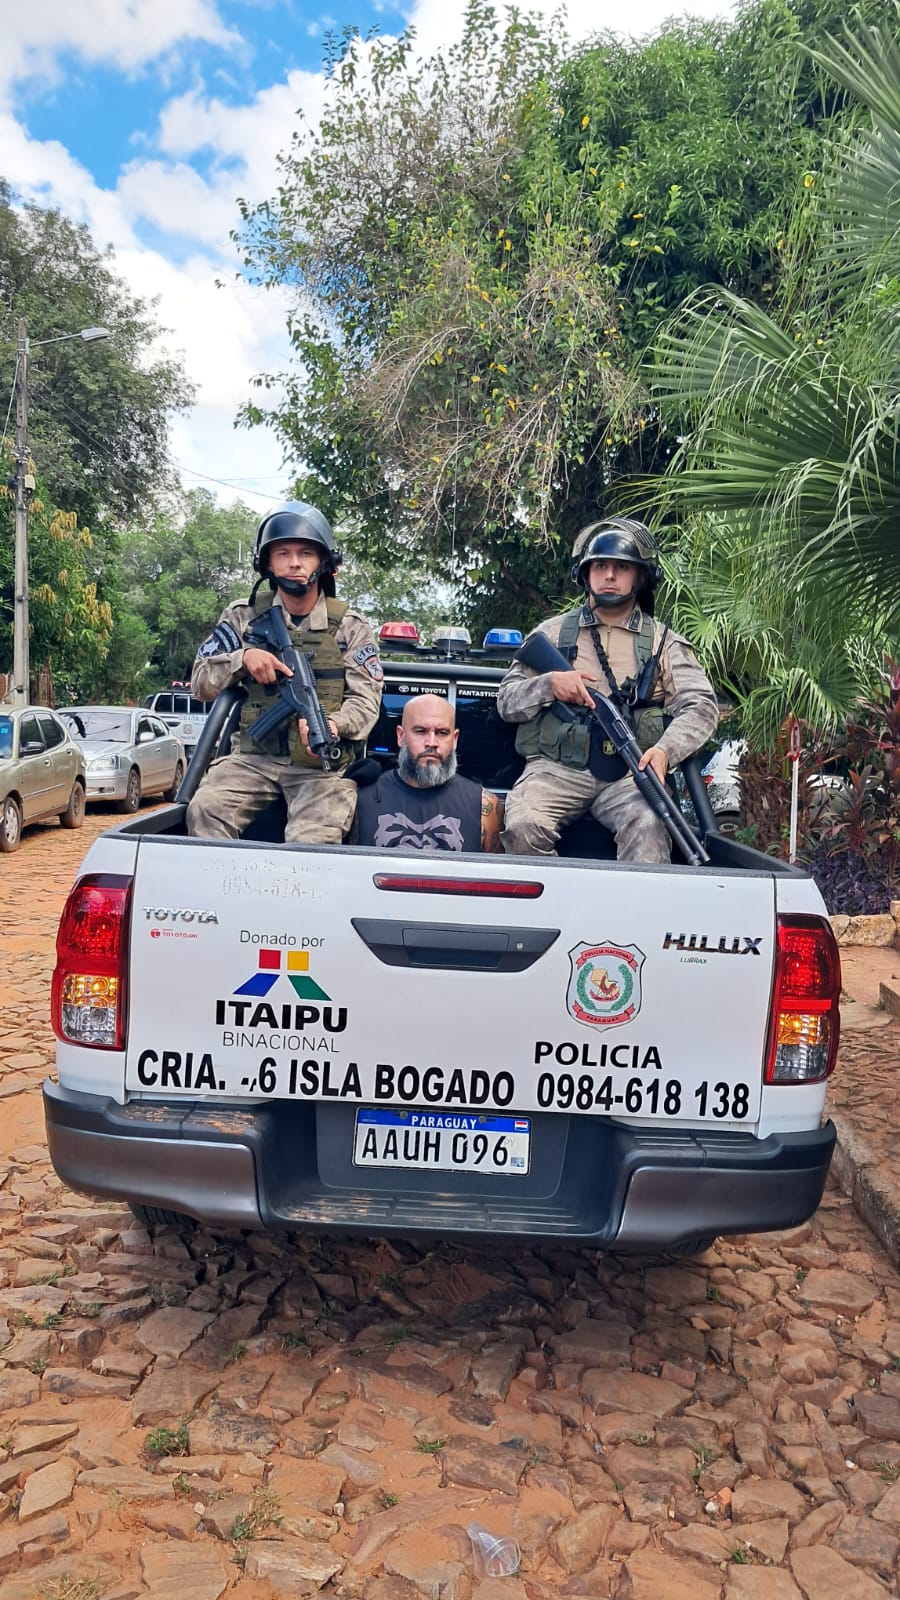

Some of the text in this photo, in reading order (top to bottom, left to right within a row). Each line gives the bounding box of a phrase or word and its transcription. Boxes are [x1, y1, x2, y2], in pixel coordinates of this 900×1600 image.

[420, 687, 447, 695] TOYOTA
[143, 906, 218, 924] TOYOTA
[240, 930, 325, 949] Donado por
[663, 932, 763, 955] HILUX
[584, 949, 631, 960] POLICIA NACIONAL
[216, 1000, 348, 1033] ITAIPU
[586, 1015, 619, 1023] PARAGUAY
[222, 1031, 340, 1053] BINACIONAL
[534, 1041, 662, 1069] POLICIA
[137, 1050, 226, 1090] CRIA.
[288, 1059, 363, 1098] ISLA
[374, 1064, 515, 1107] BOGADO
[537, 1072, 682, 1115] 0984-618
[694, 1081, 750, 1119] 138
[411, 1115, 477, 1130] PARAGUAY
[361, 1128, 508, 1166] AAUH 096
